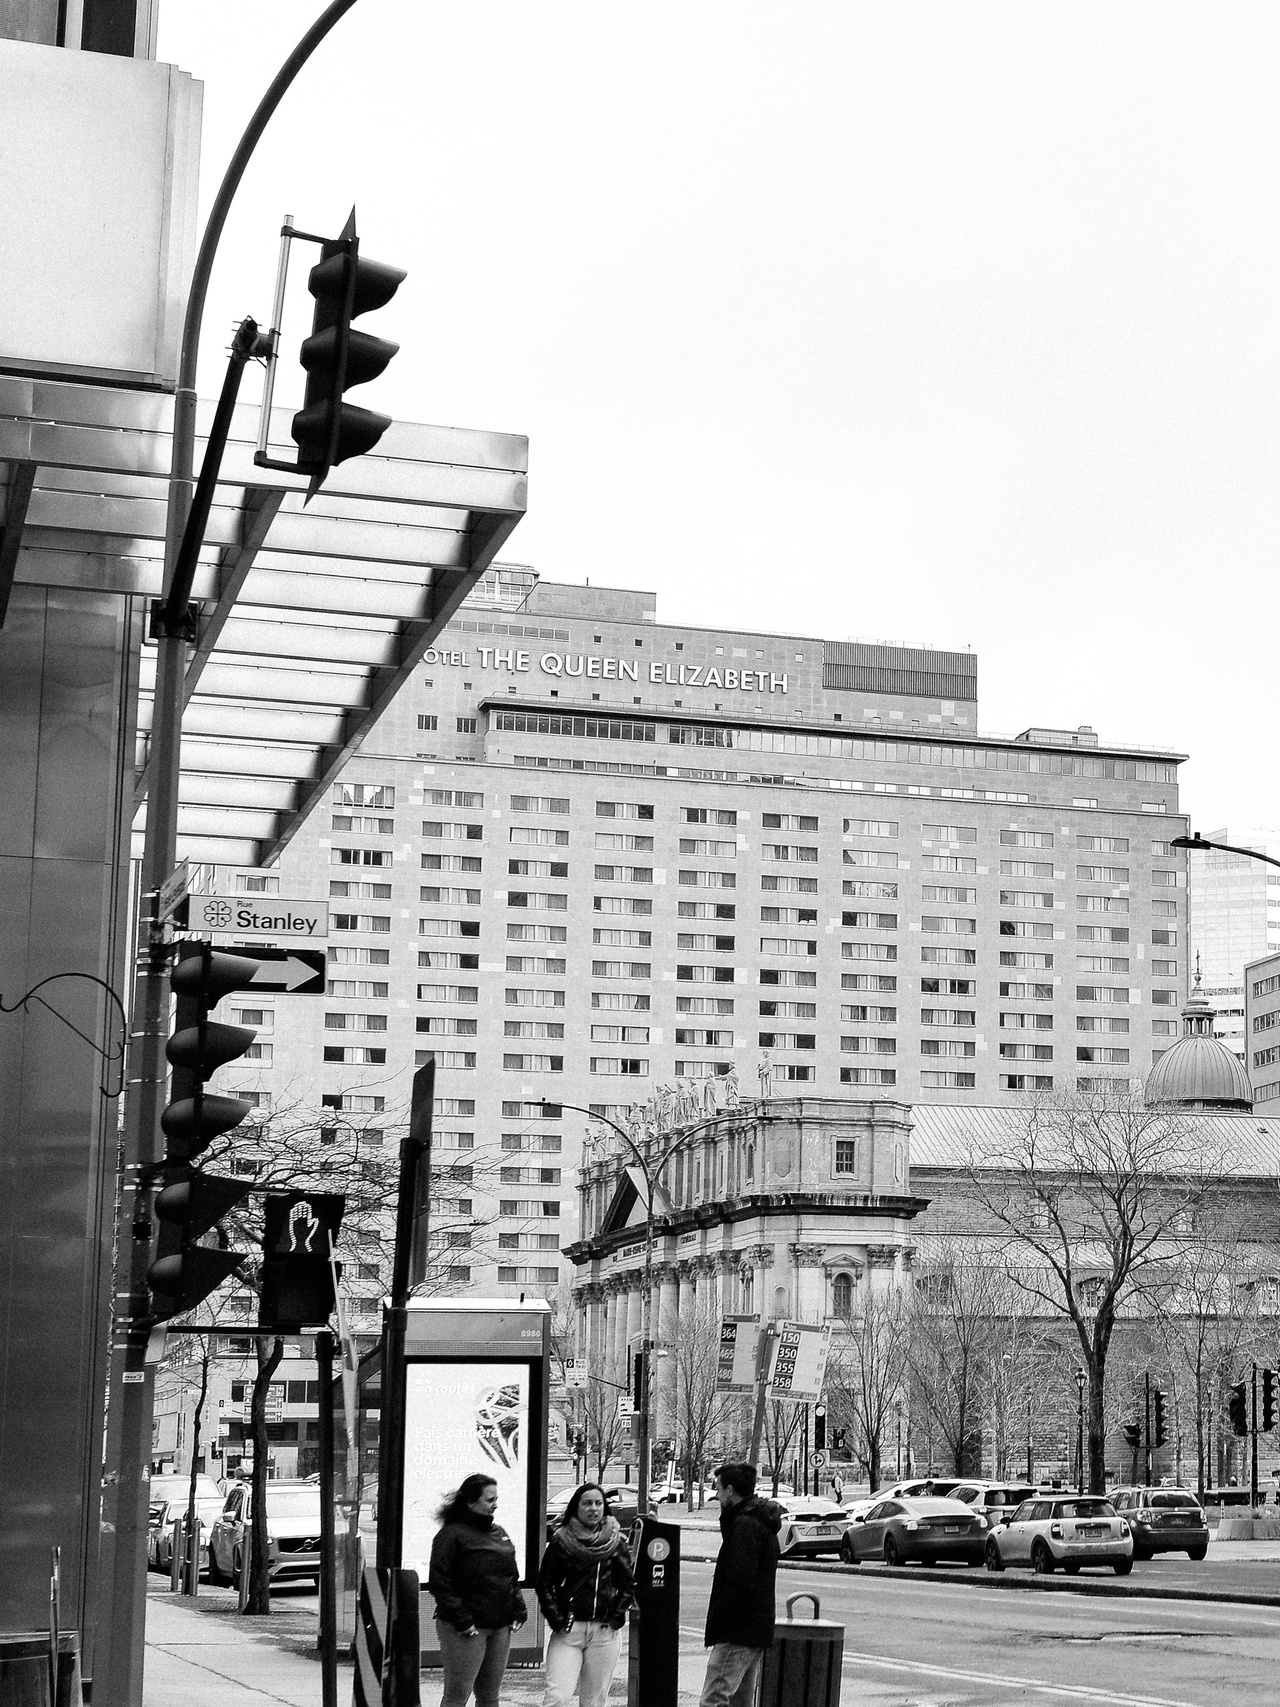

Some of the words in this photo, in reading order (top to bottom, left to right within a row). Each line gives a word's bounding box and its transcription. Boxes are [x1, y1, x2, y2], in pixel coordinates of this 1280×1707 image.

[419, 645, 470, 667] ÔTEL
[478, 647, 530, 672] THE
[540, 652, 640, 682] QUEEN
[649, 661, 788, 695] ELIZABETH
[236, 900, 253, 909] Rue
[236, 910, 318, 934] Stanley
[782, 1332, 800, 1344] 150
[778, 1347, 797, 1359] 350
[775, 1361, 794, 1374] 355
[772, 1376, 792, 1389] 358
